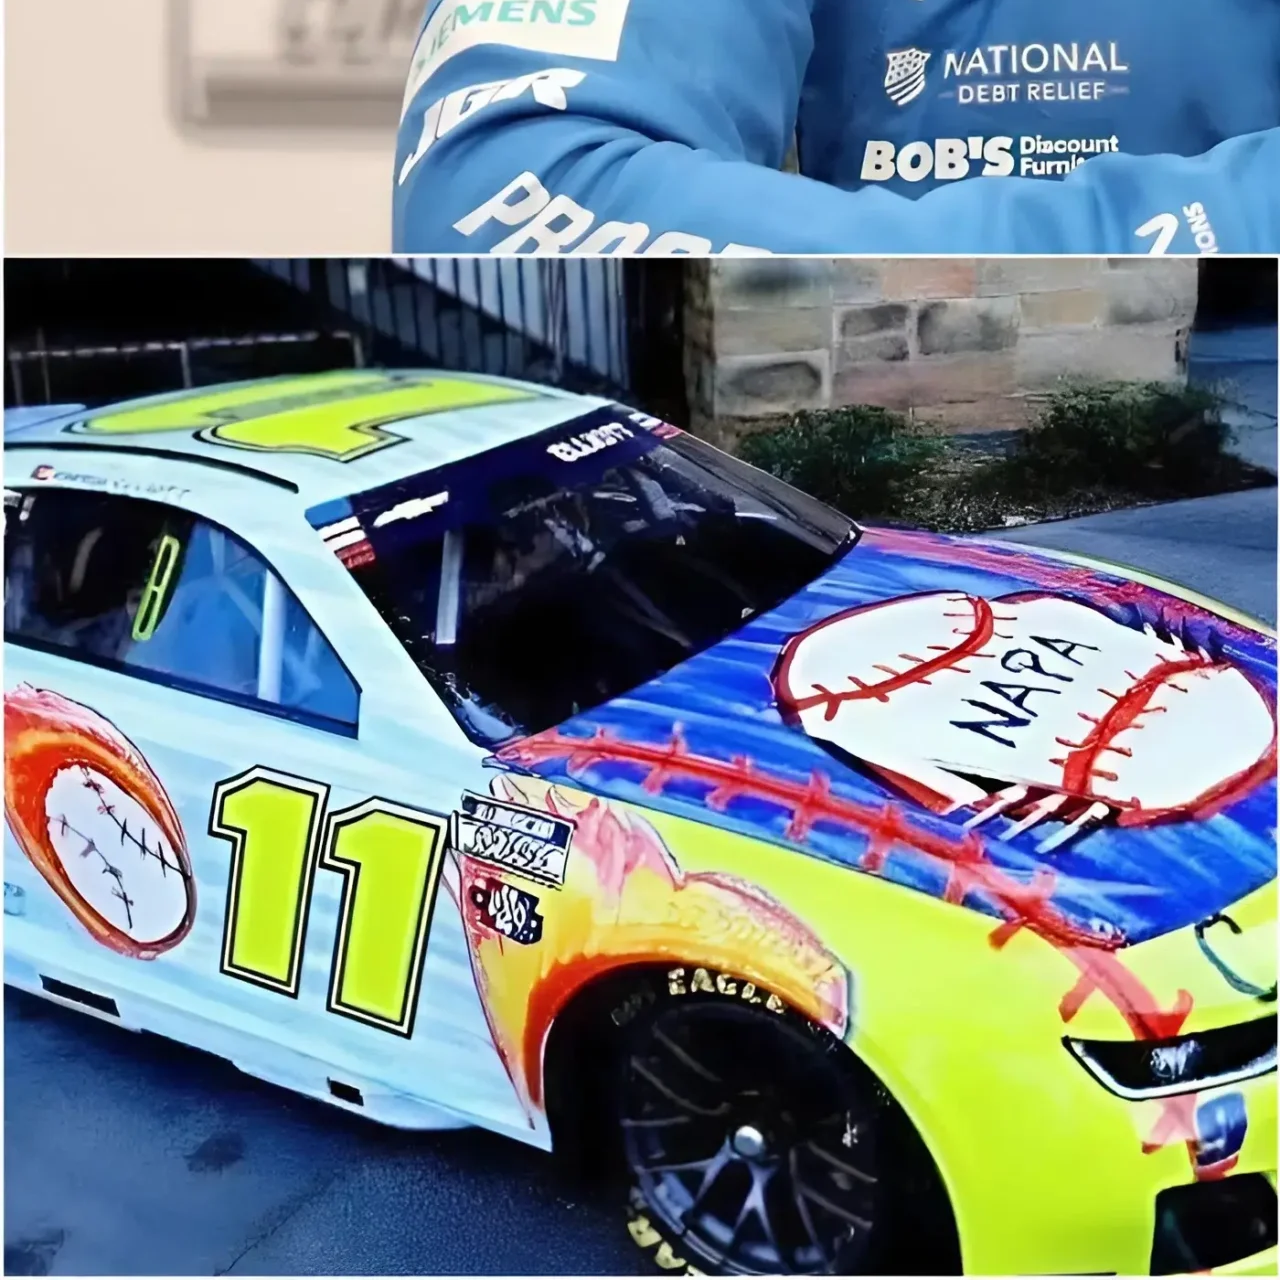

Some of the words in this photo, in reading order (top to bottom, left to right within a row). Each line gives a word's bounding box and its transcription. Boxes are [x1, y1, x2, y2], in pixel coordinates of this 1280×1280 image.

[944, 42, 1129, 80] NATIONAL
[958, 82, 1020, 105] DEBT
[1027, 81, 1106, 103] RELIEF
[860, 135, 1015, 182] BOB'S
[949, 634, 1102, 749] NAPA
[208, 764, 452, 1039] 11
[668, 967, 786, 1014] EAGLE
